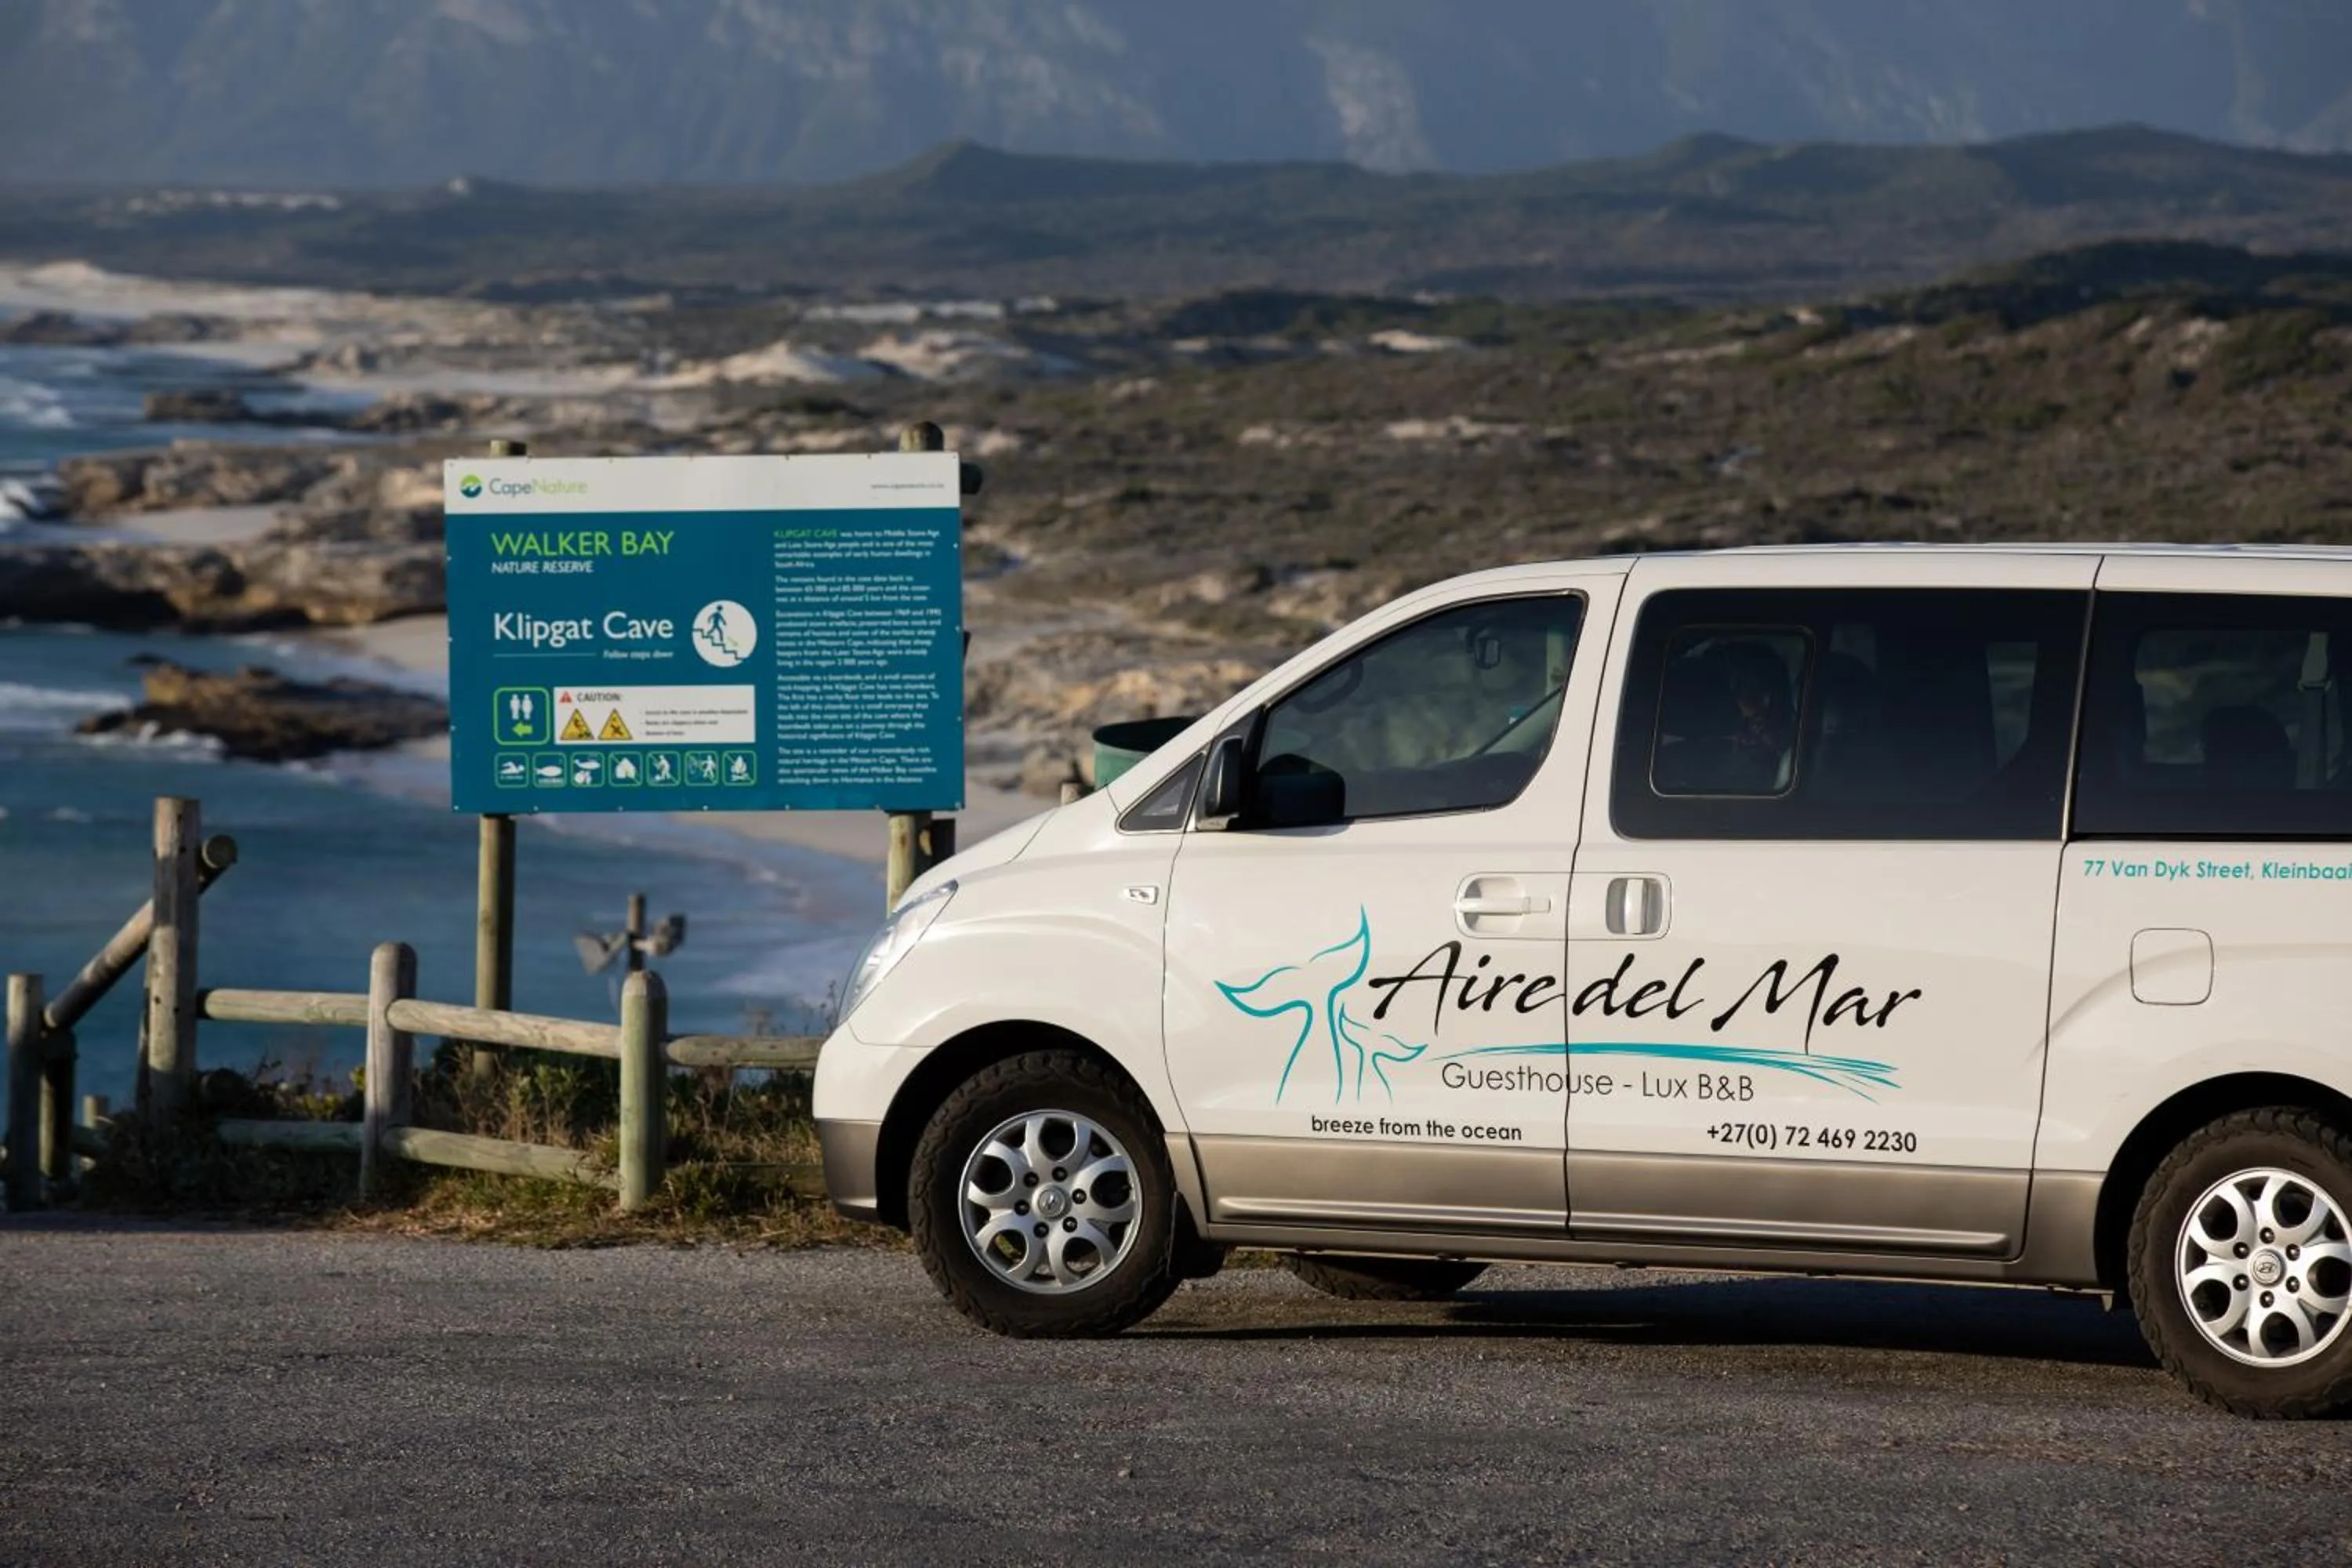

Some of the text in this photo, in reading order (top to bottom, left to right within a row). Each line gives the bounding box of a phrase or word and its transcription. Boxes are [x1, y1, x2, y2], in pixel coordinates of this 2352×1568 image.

[488, 477, 587, 498] CapeNature
[491, 530, 674, 557] WALKER BAY
[491, 560, 593, 574] NATURE RESERVE
[493, 611, 674, 648] Klipgat Cave
[2084, 860, 2106, 877] 77
[2111, 861, 2148, 877] Van
[2154, 861, 2190, 880] Dyk
[2196, 861, 2255, 880] Street,
[1368, 940, 1922, 1055] Aire del Mar
[1442, 1062, 1613, 1095] Guesthouse
[1642, 1071, 1689, 1098] Lux
[1697, 1073, 1755, 1102] B&B
[1312, 1115, 1522, 1141] breeze from the ocean
[1707, 1123, 1917, 1152] +27(0) 72 469 2230
